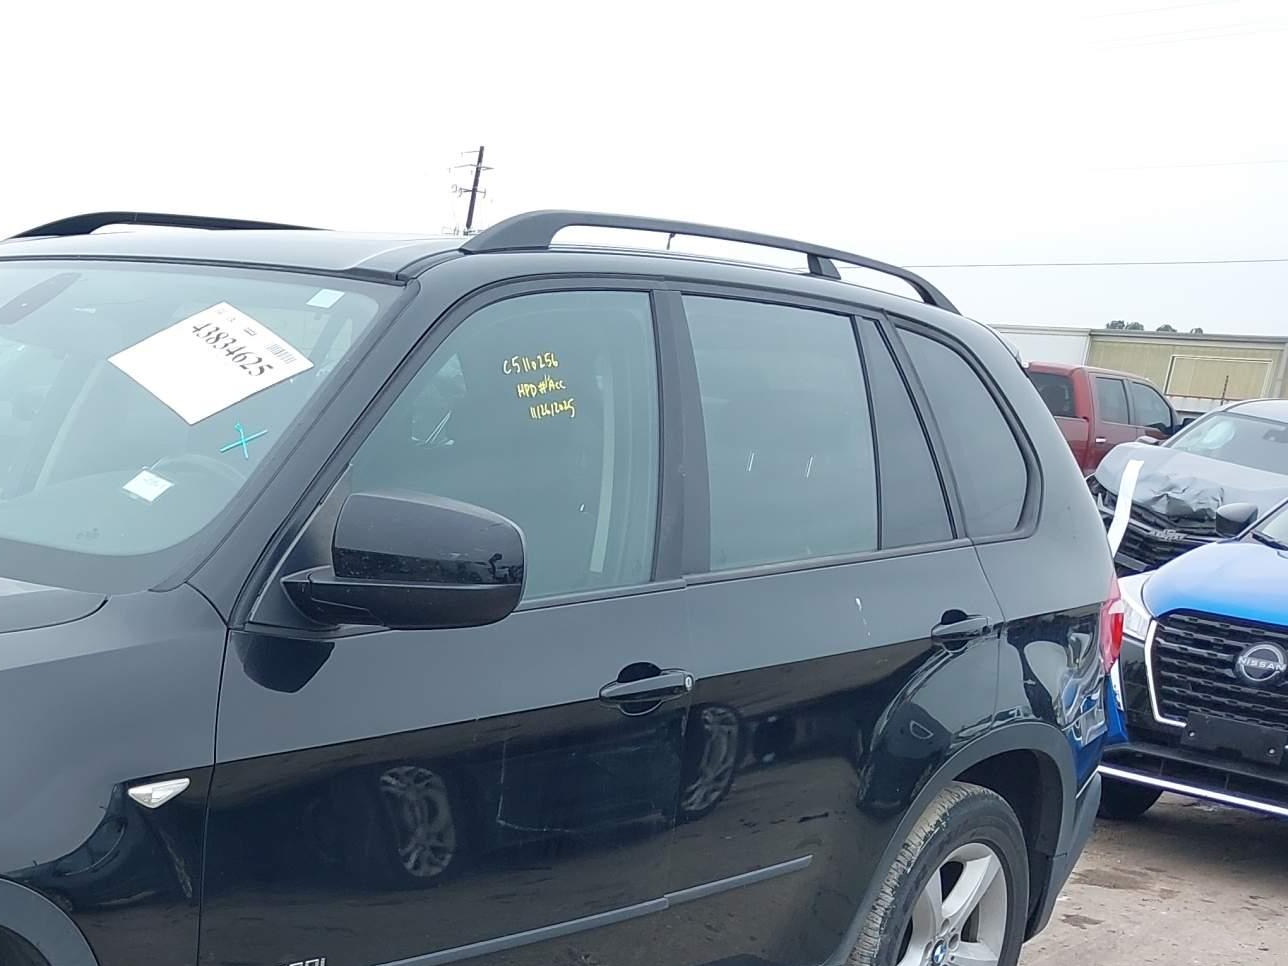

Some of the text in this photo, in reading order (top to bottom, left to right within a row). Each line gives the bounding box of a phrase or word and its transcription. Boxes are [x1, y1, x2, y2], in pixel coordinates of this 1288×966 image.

[192, 322, 274, 377] 43834625
[517, 383, 537, 398] HPD
[1238, 655, 1287, 672] NISSAN
